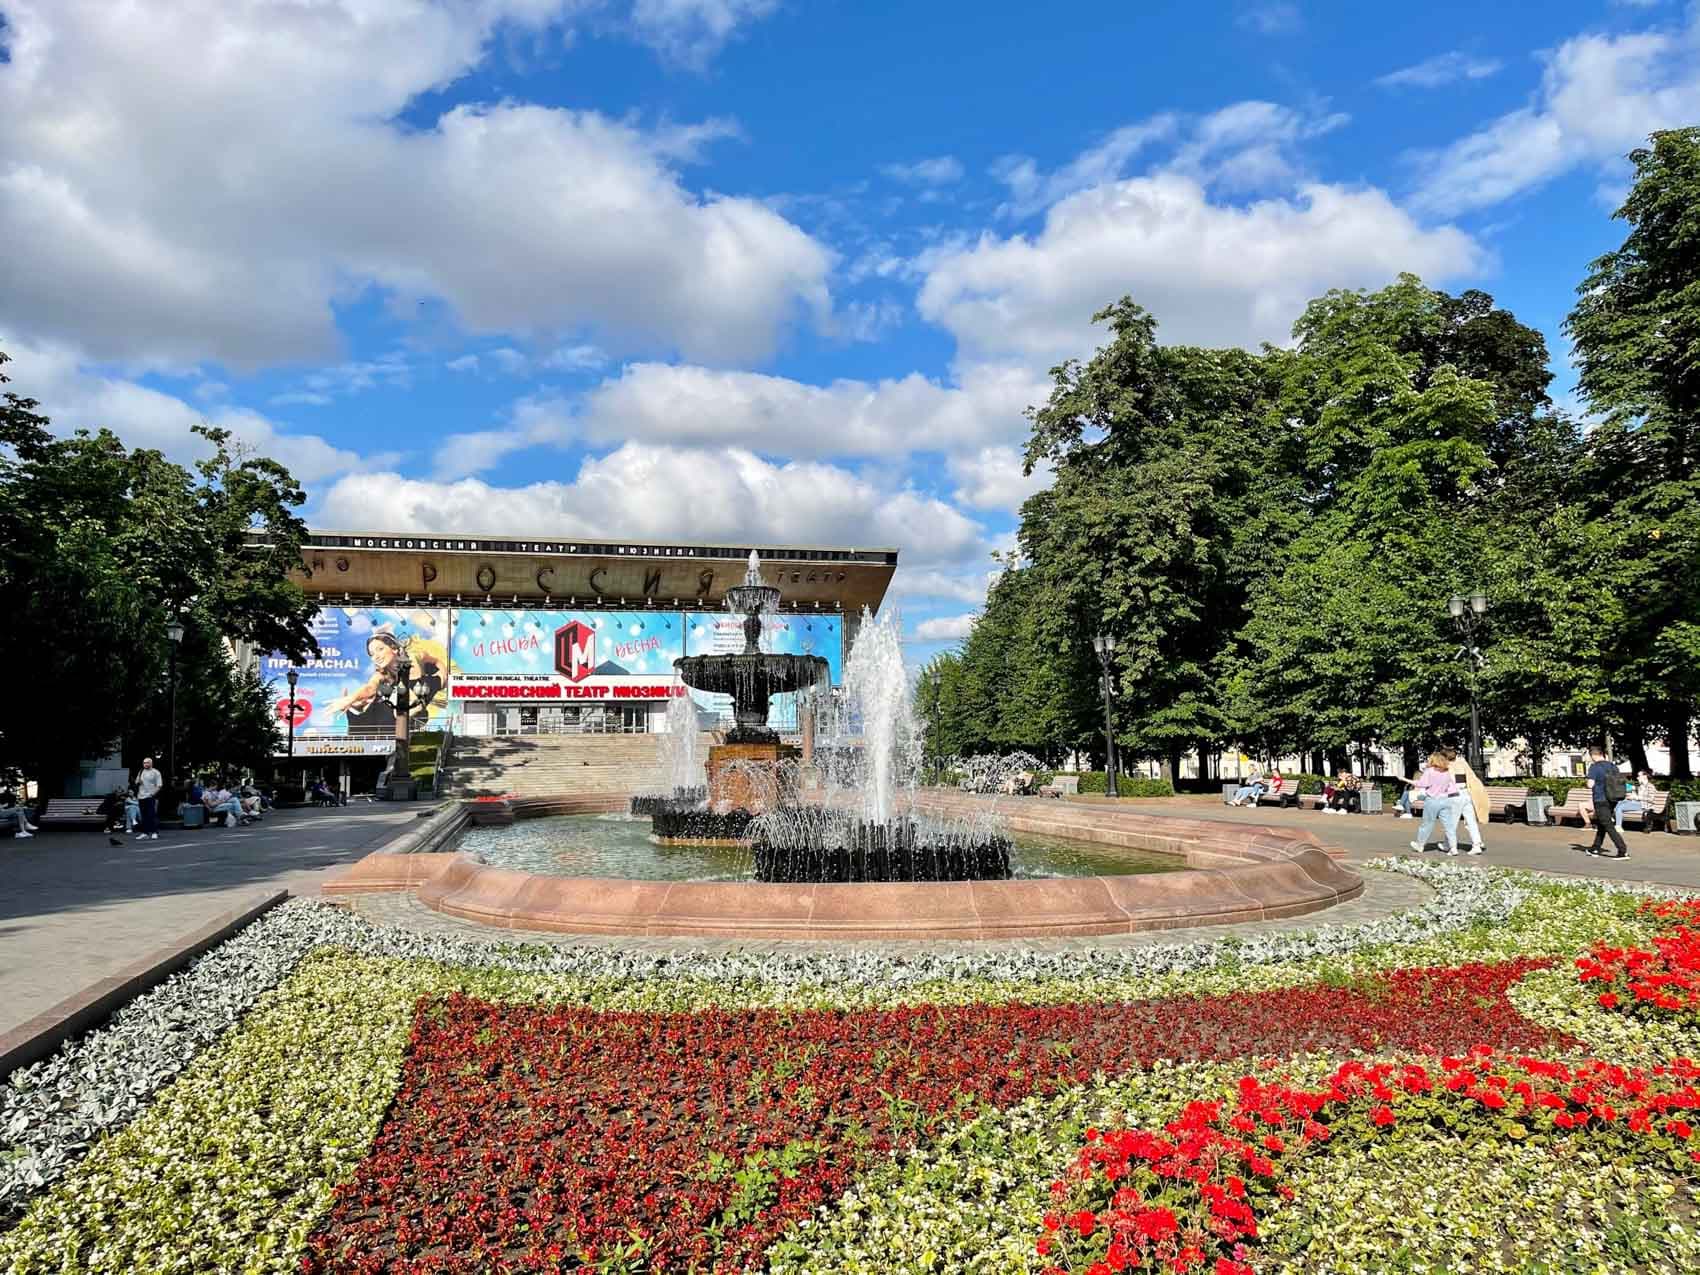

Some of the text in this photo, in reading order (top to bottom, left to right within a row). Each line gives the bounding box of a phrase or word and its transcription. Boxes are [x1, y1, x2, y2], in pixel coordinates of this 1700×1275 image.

[520, 543, 577, 552] ТЕАТР
[618, 547, 695, 556] МЮЗИКЛА
[421, 562, 715, 596] РОССИЯ
[452, 682, 562, 698] МОСКОВСКИЙ
[564, 685, 610, 698] ТЕАТР
